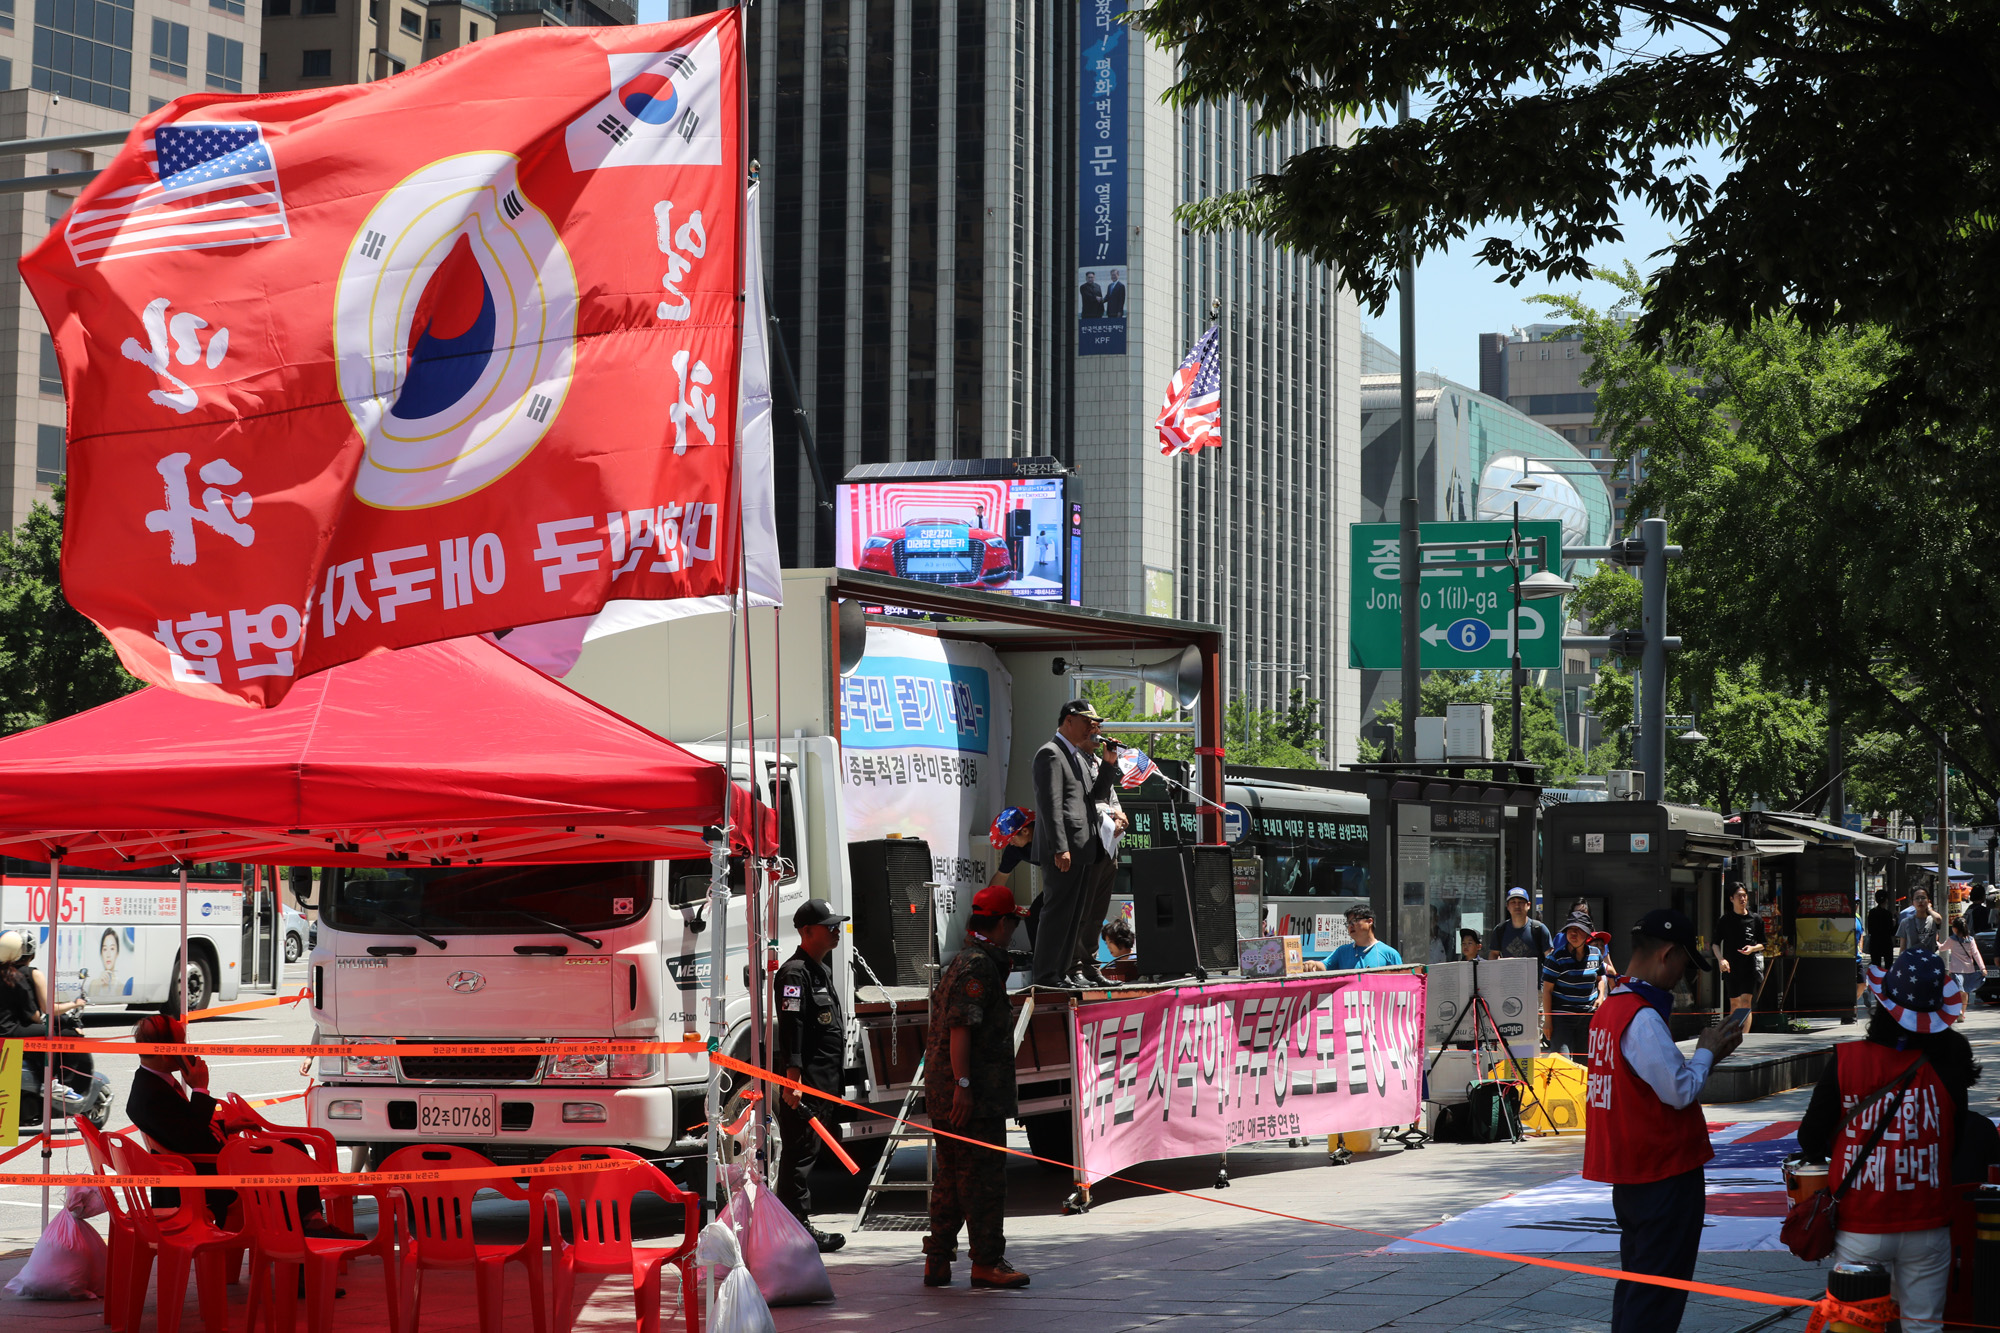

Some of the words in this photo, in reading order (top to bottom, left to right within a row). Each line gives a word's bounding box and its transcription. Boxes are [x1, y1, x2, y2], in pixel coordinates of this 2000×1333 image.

[1089, 145, 1117, 176] 문
[921, 529, 953, 539] 친환경차
[1438, 587, 1498, 614] 1(il)-ga
[1461, 623, 1477, 647] 6
[1135, 813, 1151, 832] 일산
[1262, 818, 1283, 836] 연세대
[1317, 822, 1337, 840] 광화문
[26, 886, 86, 923] 105-1
[337, 958, 388, 969] HYUNDAI
[565, 957, 610, 966] GOLD
[1499, 1025, 1522, 1035] chicco
[1247, 1112, 1301, 1139] 애국총연합
[595, 1161, 620, 1169] SAFETY
[1894, 1142, 1940, 1191] 반대
[36, 1176, 62, 1184] SAFETY
